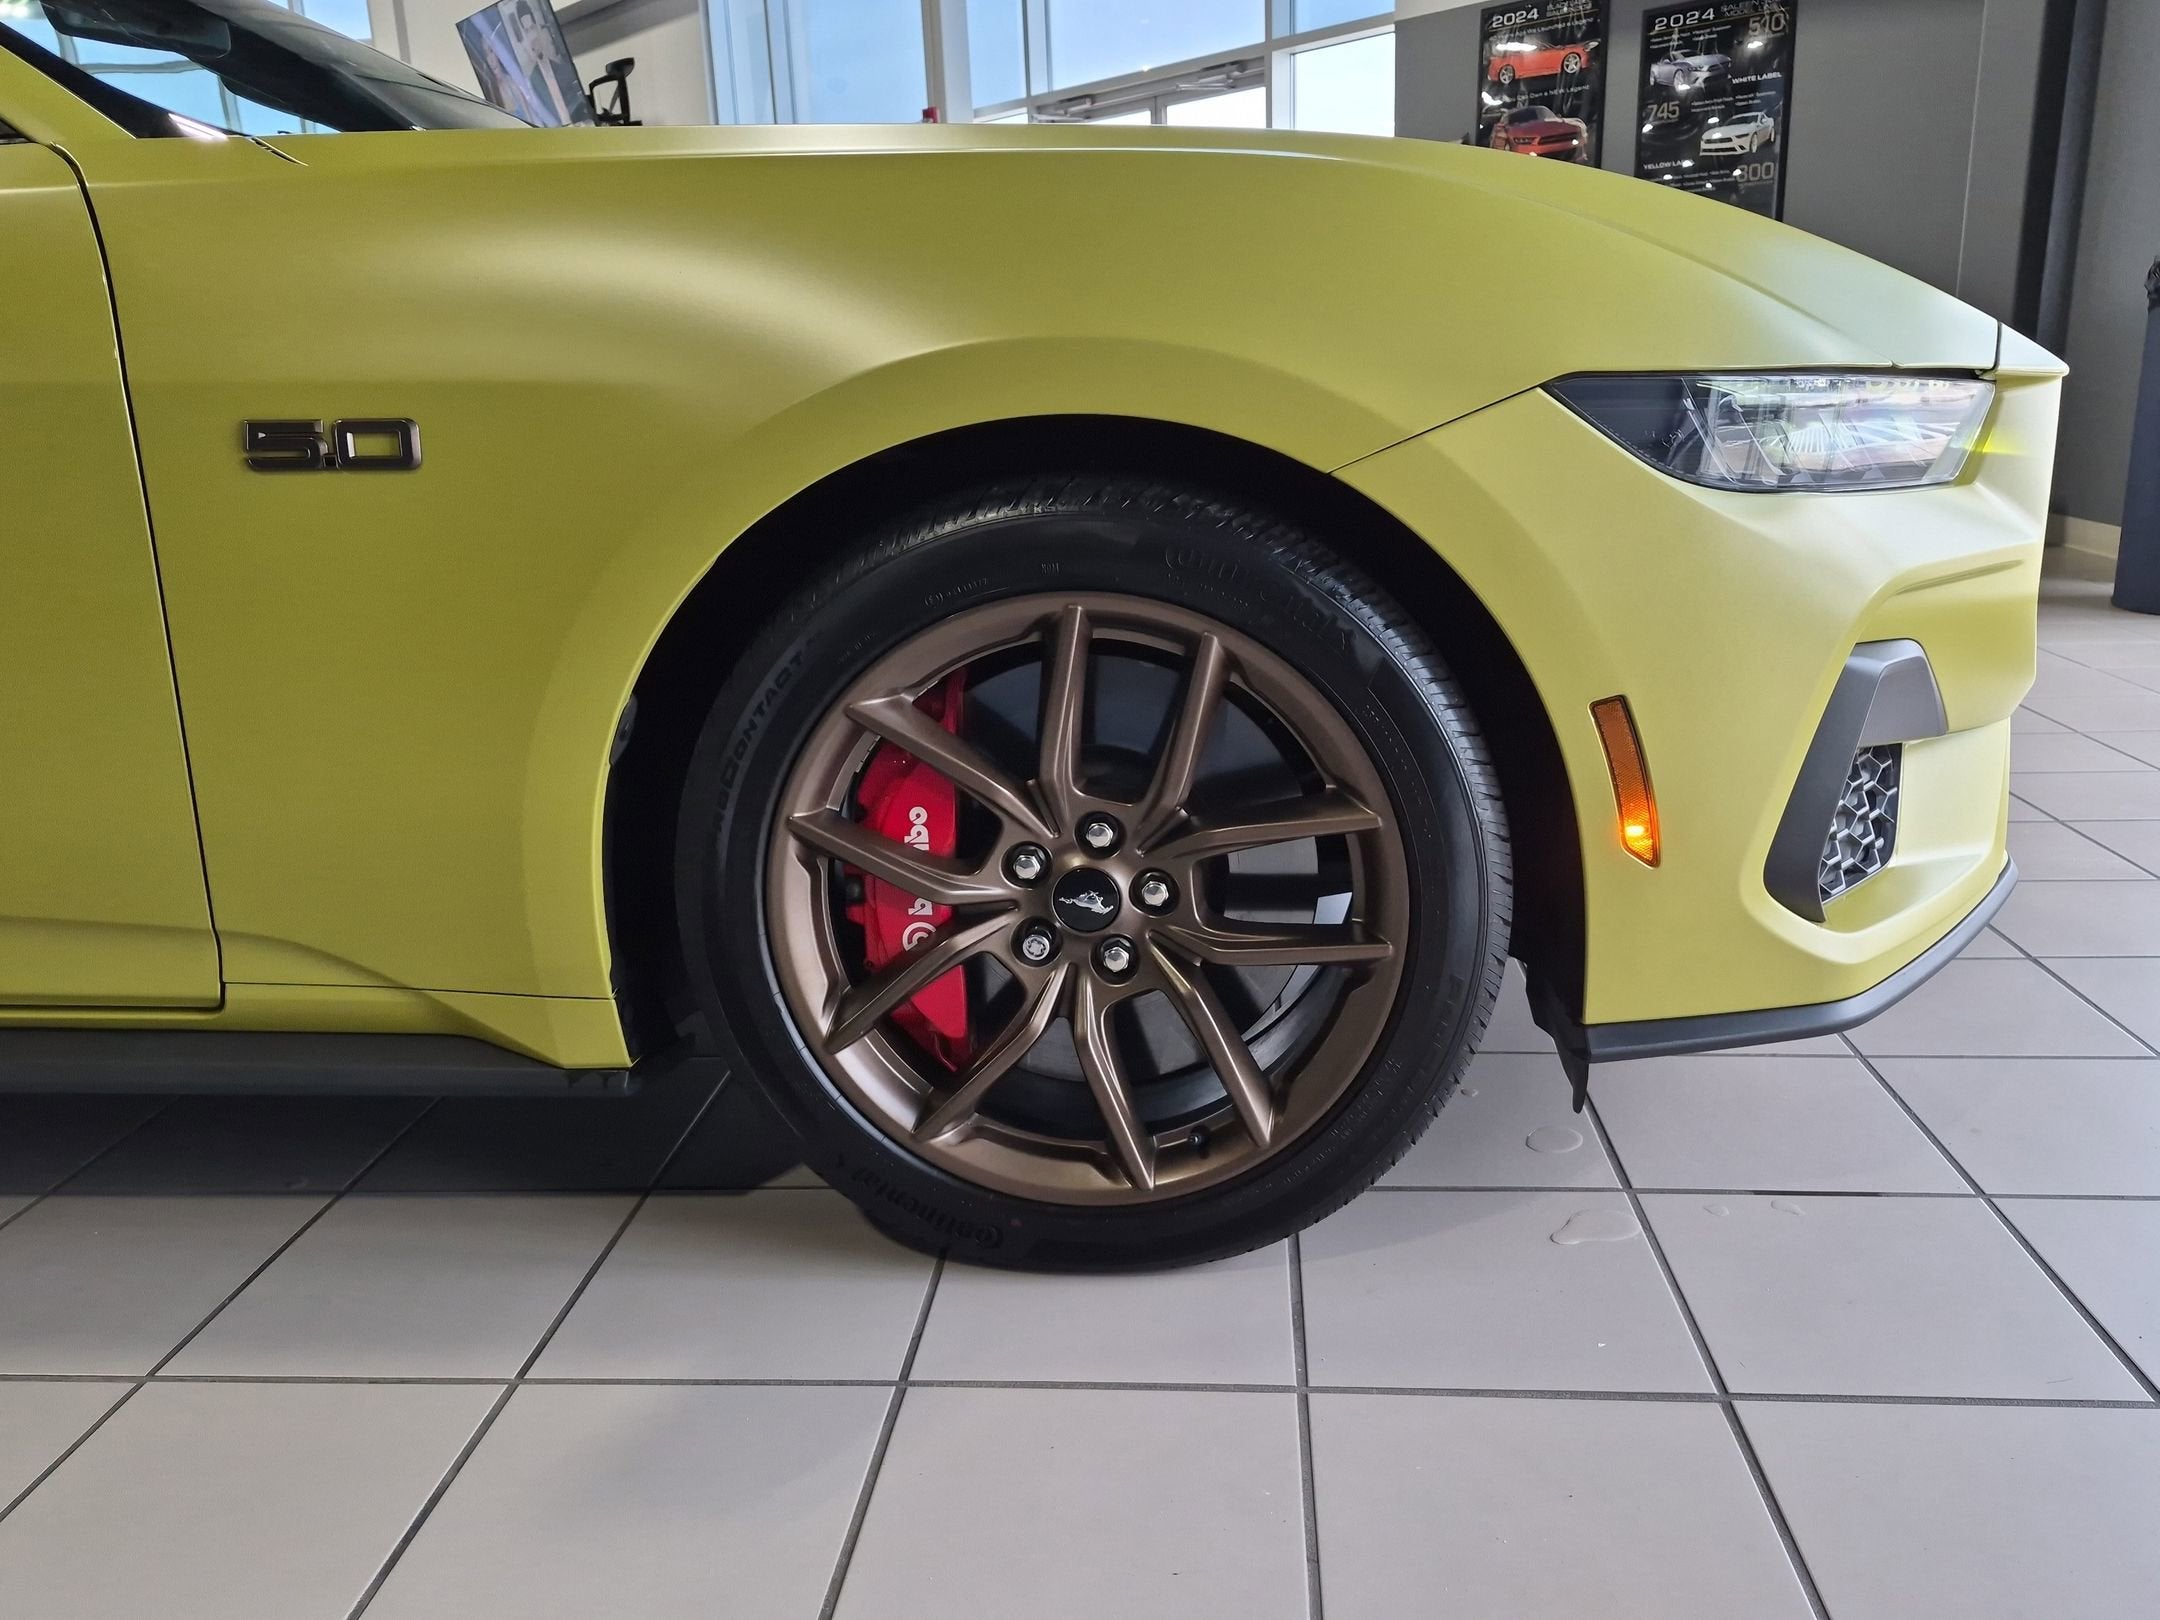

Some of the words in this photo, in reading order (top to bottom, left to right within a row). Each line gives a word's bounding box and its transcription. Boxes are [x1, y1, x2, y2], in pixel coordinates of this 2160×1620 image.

[1492, 8, 1539, 28] 2024
[1654, 8, 1715, 31] 2024
[1732, 75, 1757, 84] WHITE
[1757, 72, 1782, 80] LABEL
[1648, 101, 1680, 120] 745
[1643, 160, 1672, 170] YELLOW
[243, 417, 422, 470] 5.0
